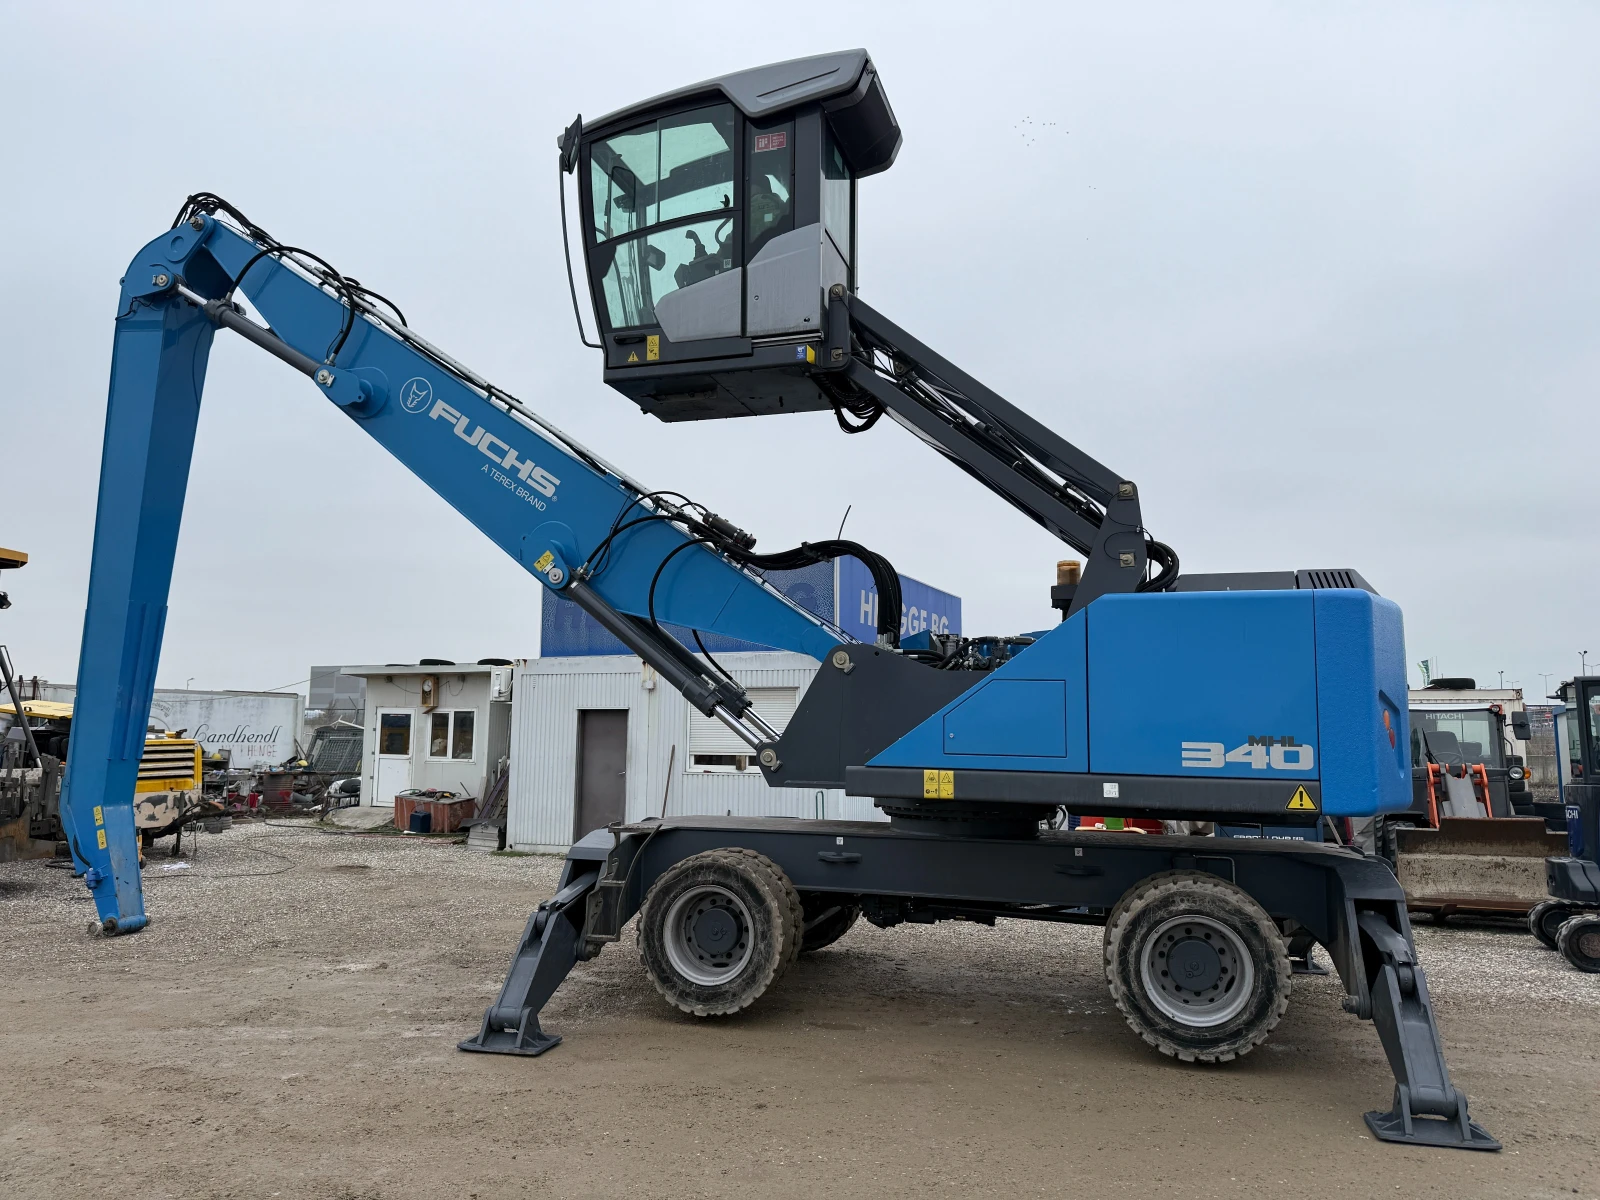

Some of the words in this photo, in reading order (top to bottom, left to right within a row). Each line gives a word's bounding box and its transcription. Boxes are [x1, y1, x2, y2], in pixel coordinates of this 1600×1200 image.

[428, 398, 561, 498] FUCHS
[481, 464, 489, 473] A
[489, 467, 518, 492] TEREX
[516, 487, 547, 512] BRAND
[860, 589, 928, 635] HGGE
[193, 723, 283, 743] Landhendl
[1247, 735, 1303, 747] MHL
[1181, 741, 1314, 770] 340
